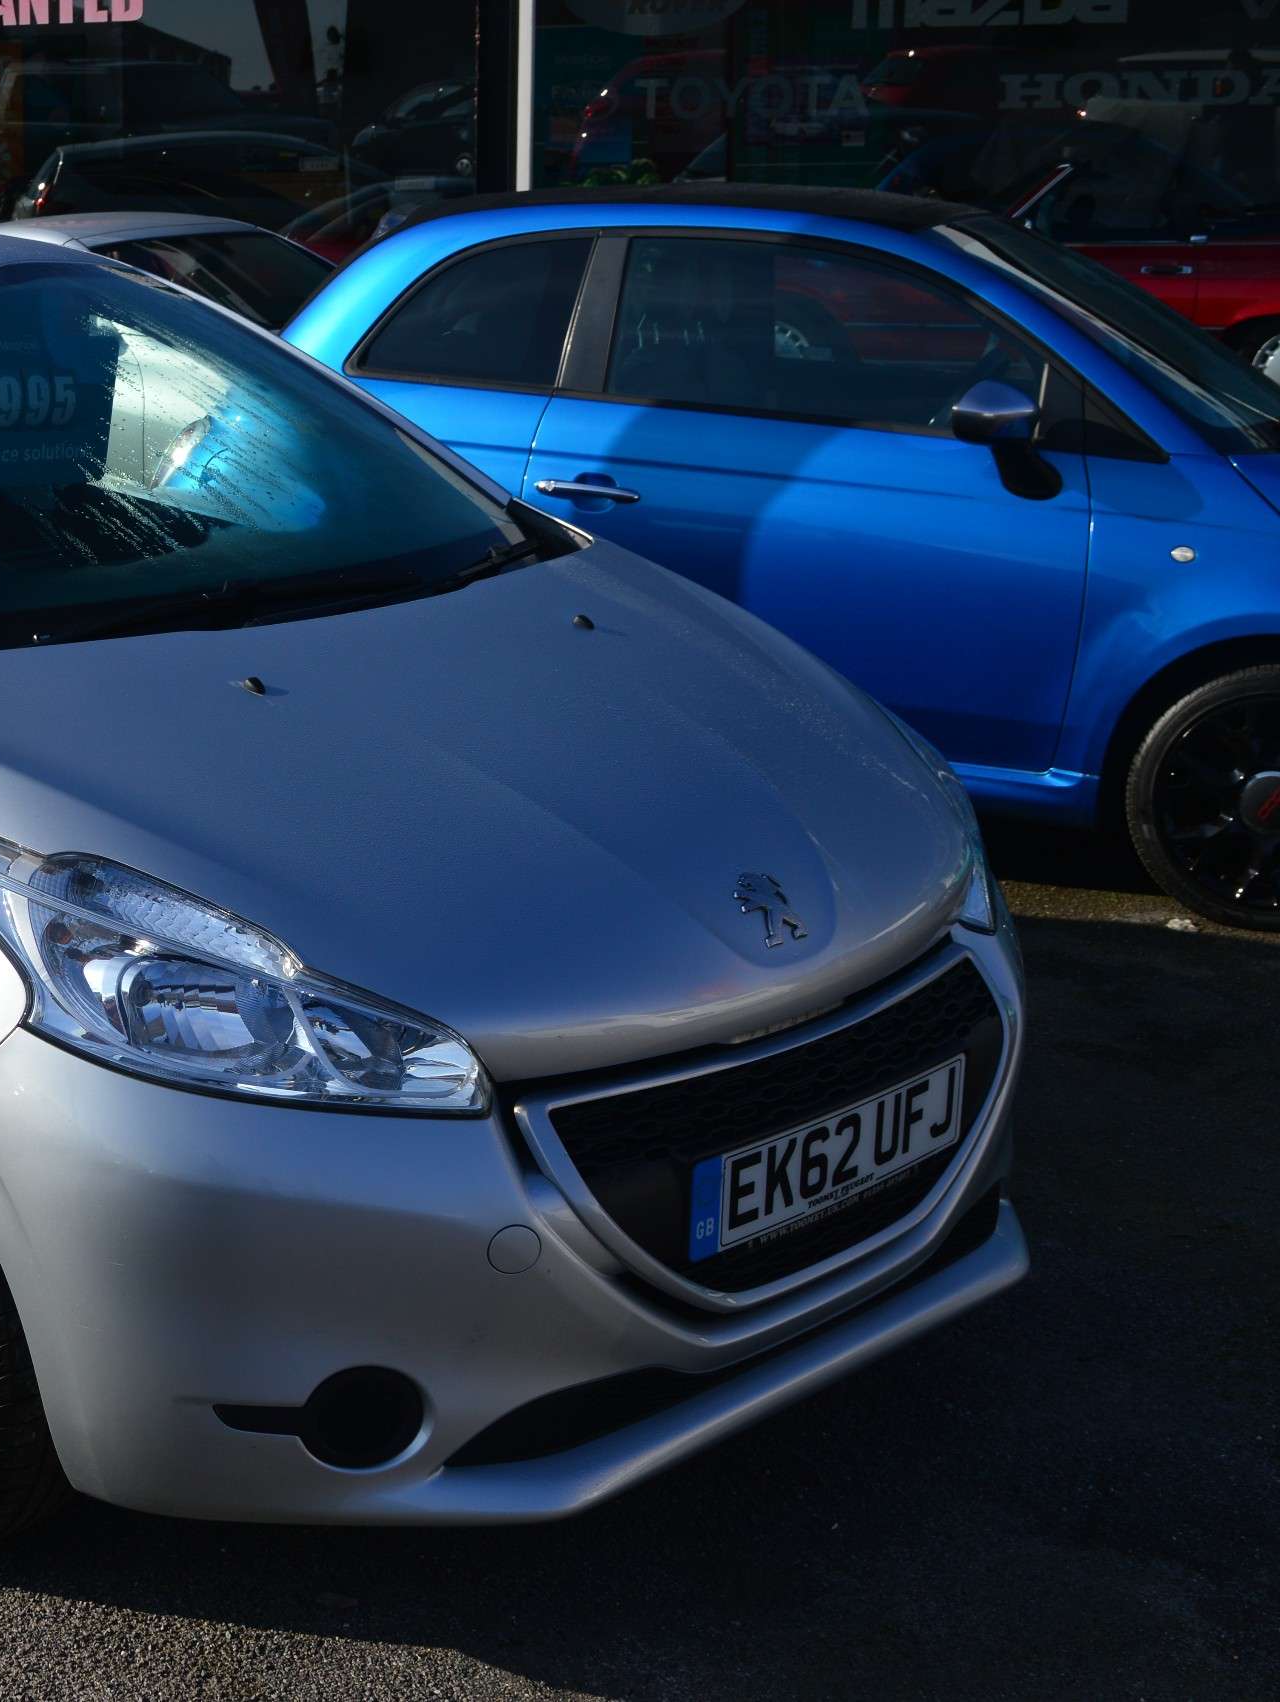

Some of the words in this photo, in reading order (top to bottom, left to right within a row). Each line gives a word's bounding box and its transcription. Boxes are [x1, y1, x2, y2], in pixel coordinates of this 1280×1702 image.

[635, 74, 871, 119] TOYOTA
[23, 441, 91, 463] solution
[728, 1112, 862, 1231] EK62
[874, 1067, 956, 1167] UFJ
[696, 1216, 715, 1241] GB
